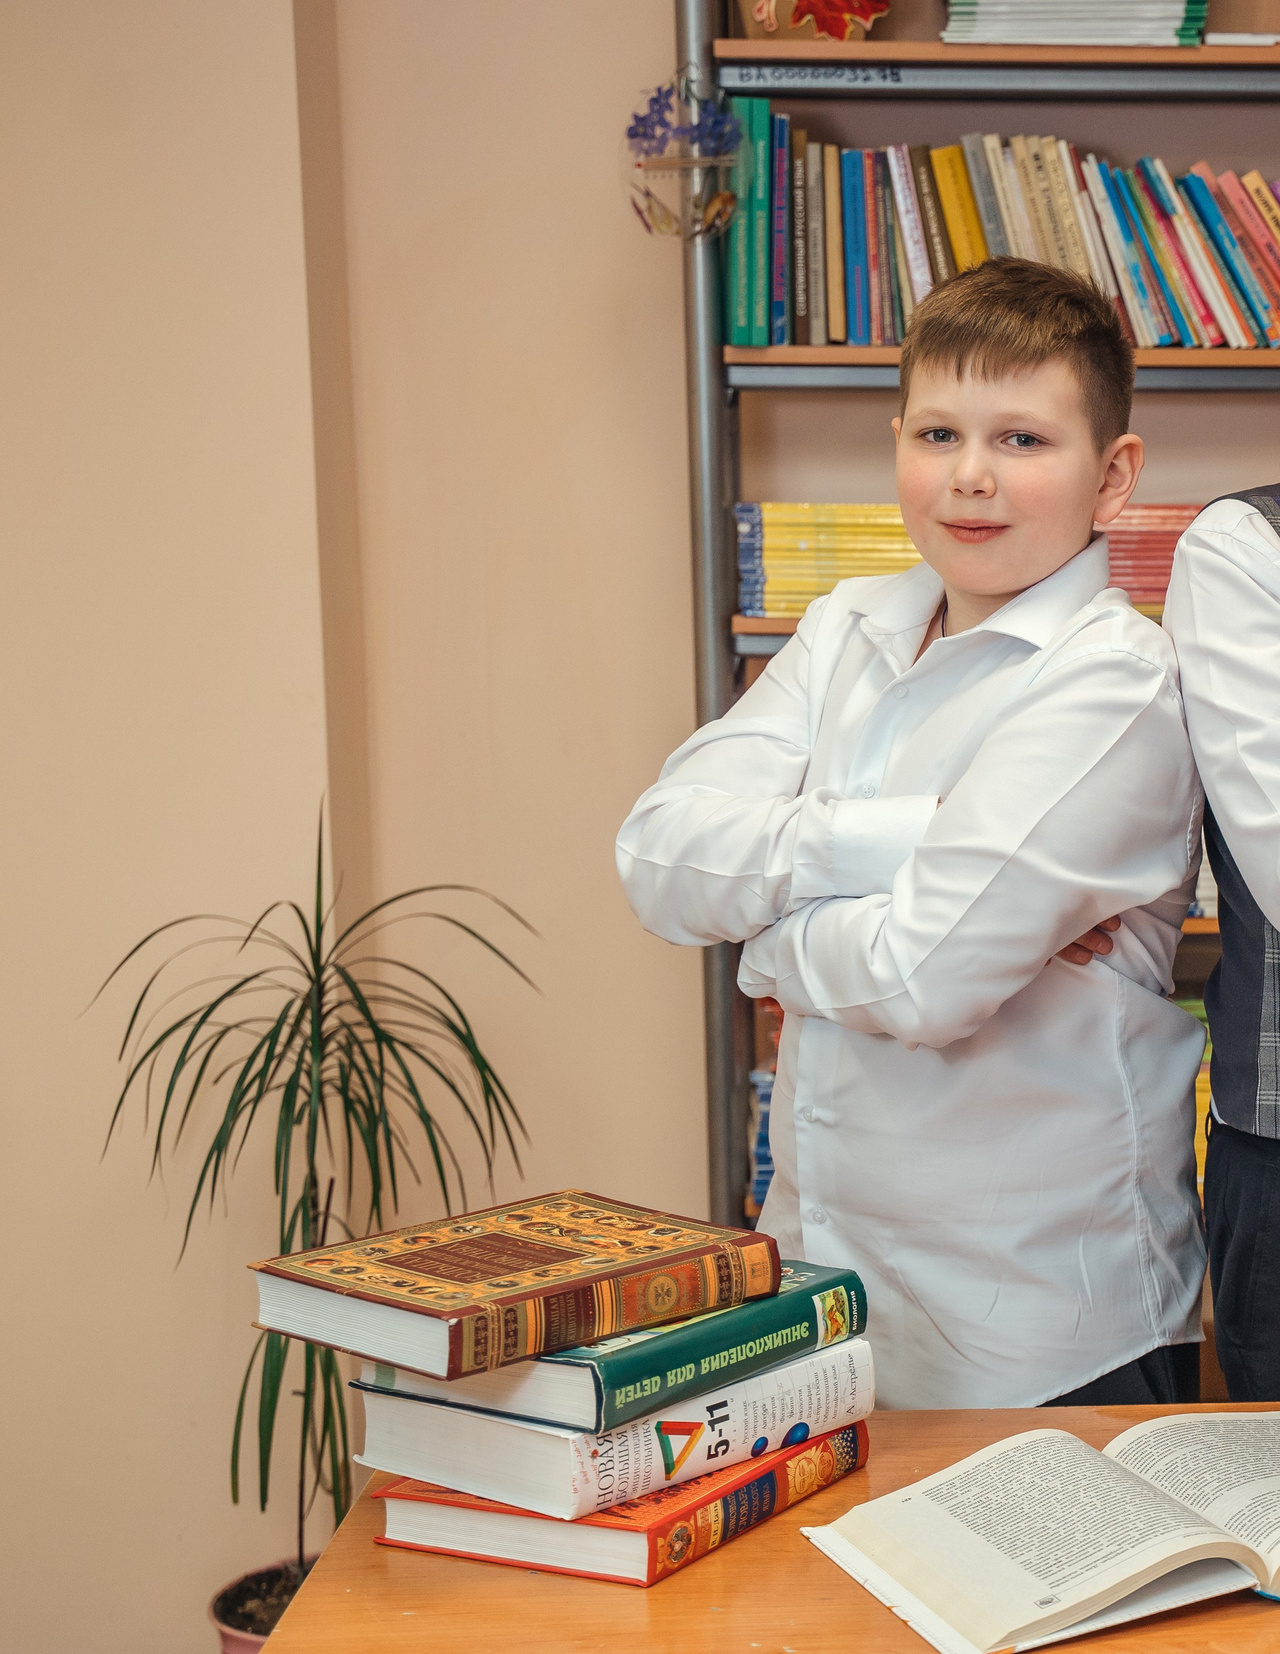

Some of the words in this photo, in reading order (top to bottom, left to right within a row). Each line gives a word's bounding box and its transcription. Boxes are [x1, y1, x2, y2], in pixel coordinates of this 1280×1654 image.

[550, 1297, 559, 1347] БОЛЬШАЯ
[565, 1291, 577, 1341] ЖИВОТНЫХ
[850, 1290, 858, 1331] БИОЛОГИЯ
[700, 1321, 810, 1375] ЭНЦИКЛОПЕДИЯ
[614, 1375, 661, 1409] ДЕТЕЙ
[666, 1363, 696, 1388] ДЛЯ
[706, 1399, 730, 1460] 5-11
[814, 1399, 822, 1425] История
[596, 1432, 615, 1508] НОВАЯ
[615, 1429, 630, 1501] БОЛЬШАЯ
[630, 1422, 642, 1496] ЭНЦИКЛОПЕДИЯ
[641, 1418, 653, 1492] ШКОЛЬНИКА
[738, 1486, 749, 1532] СЛОВАРЬ
[750, 1481, 760, 1525] РУССКОГО
[762, 1482, 771, 1512] ЯЗЫКА
